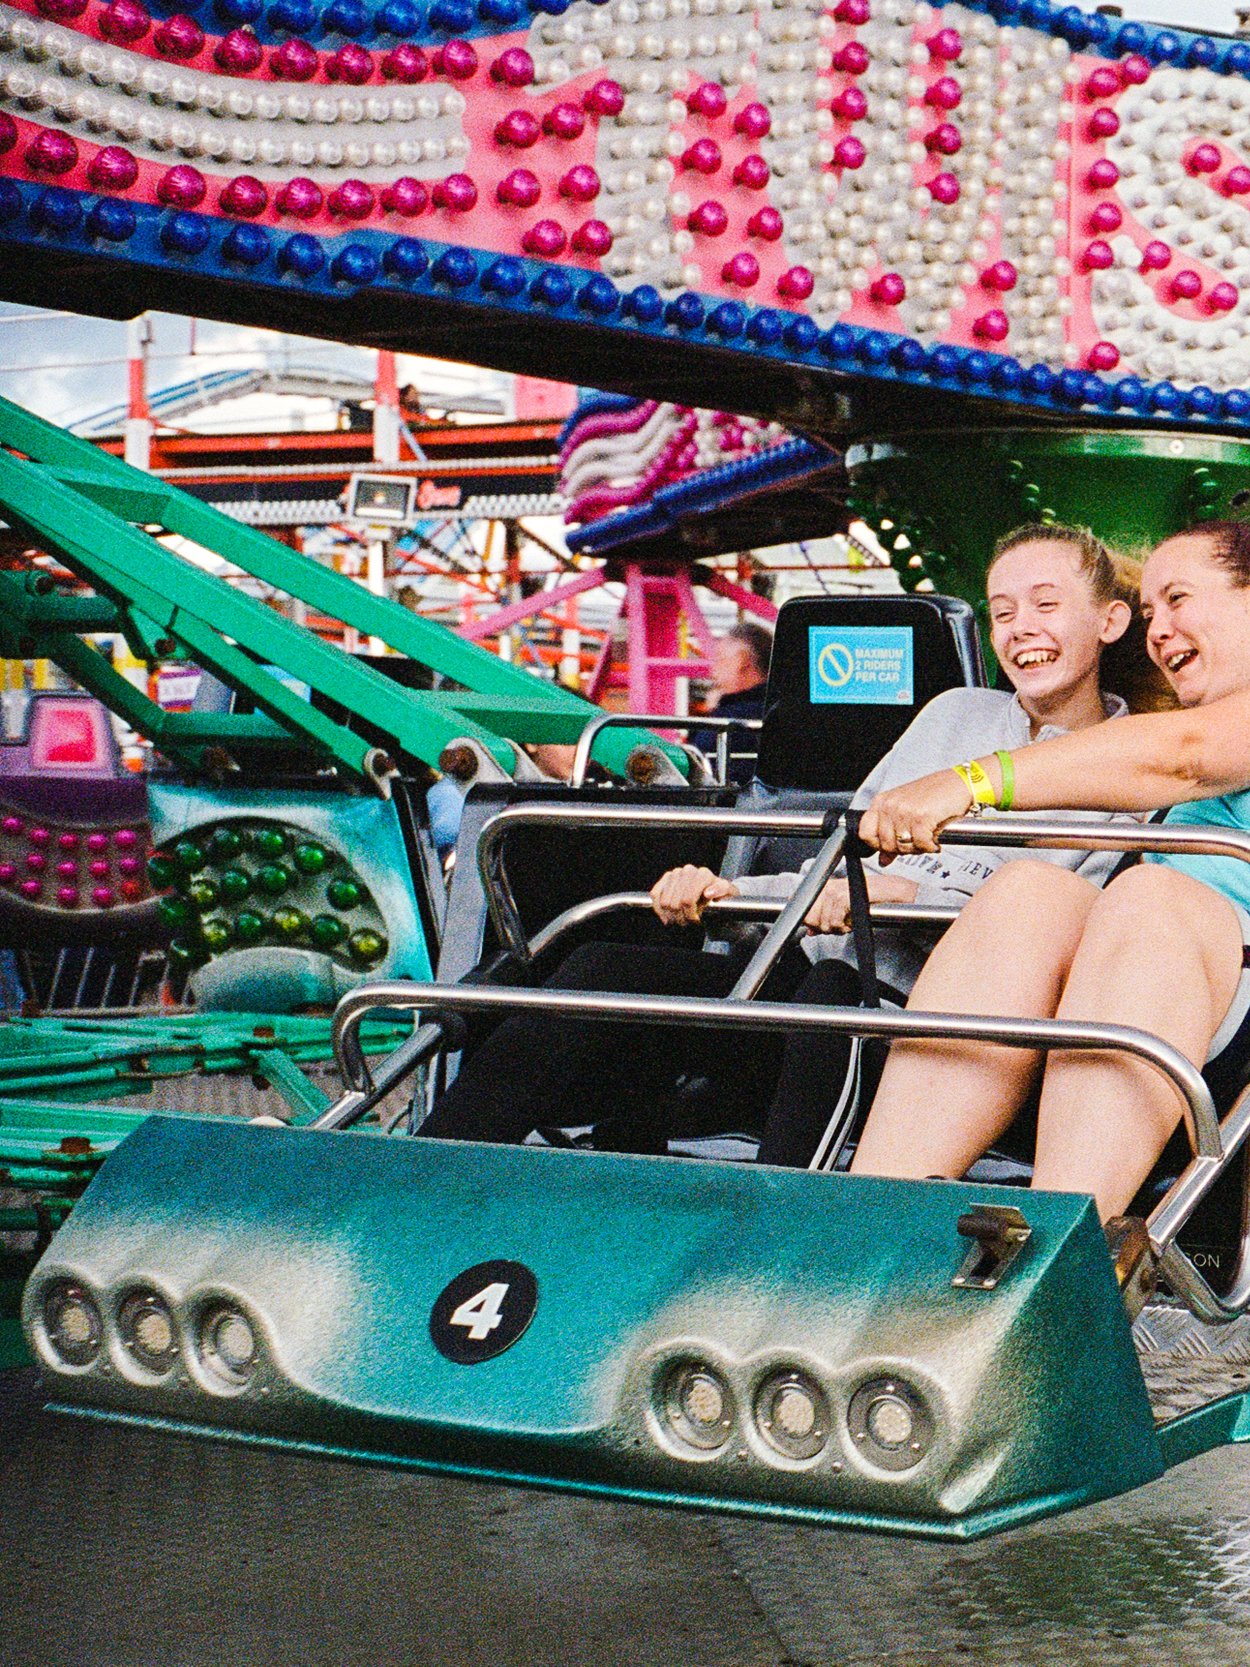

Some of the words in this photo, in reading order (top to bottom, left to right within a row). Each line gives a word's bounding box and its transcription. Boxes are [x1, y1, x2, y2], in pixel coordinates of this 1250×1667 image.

[855, 648, 904, 659] MAXIMUM
[854, 661, 862, 671] 2
[864, 660, 902, 671] RIDERS
[855, 672, 877, 683] PER
[878, 672, 900, 683] CAR
[449, 1282, 510, 1340] 4
